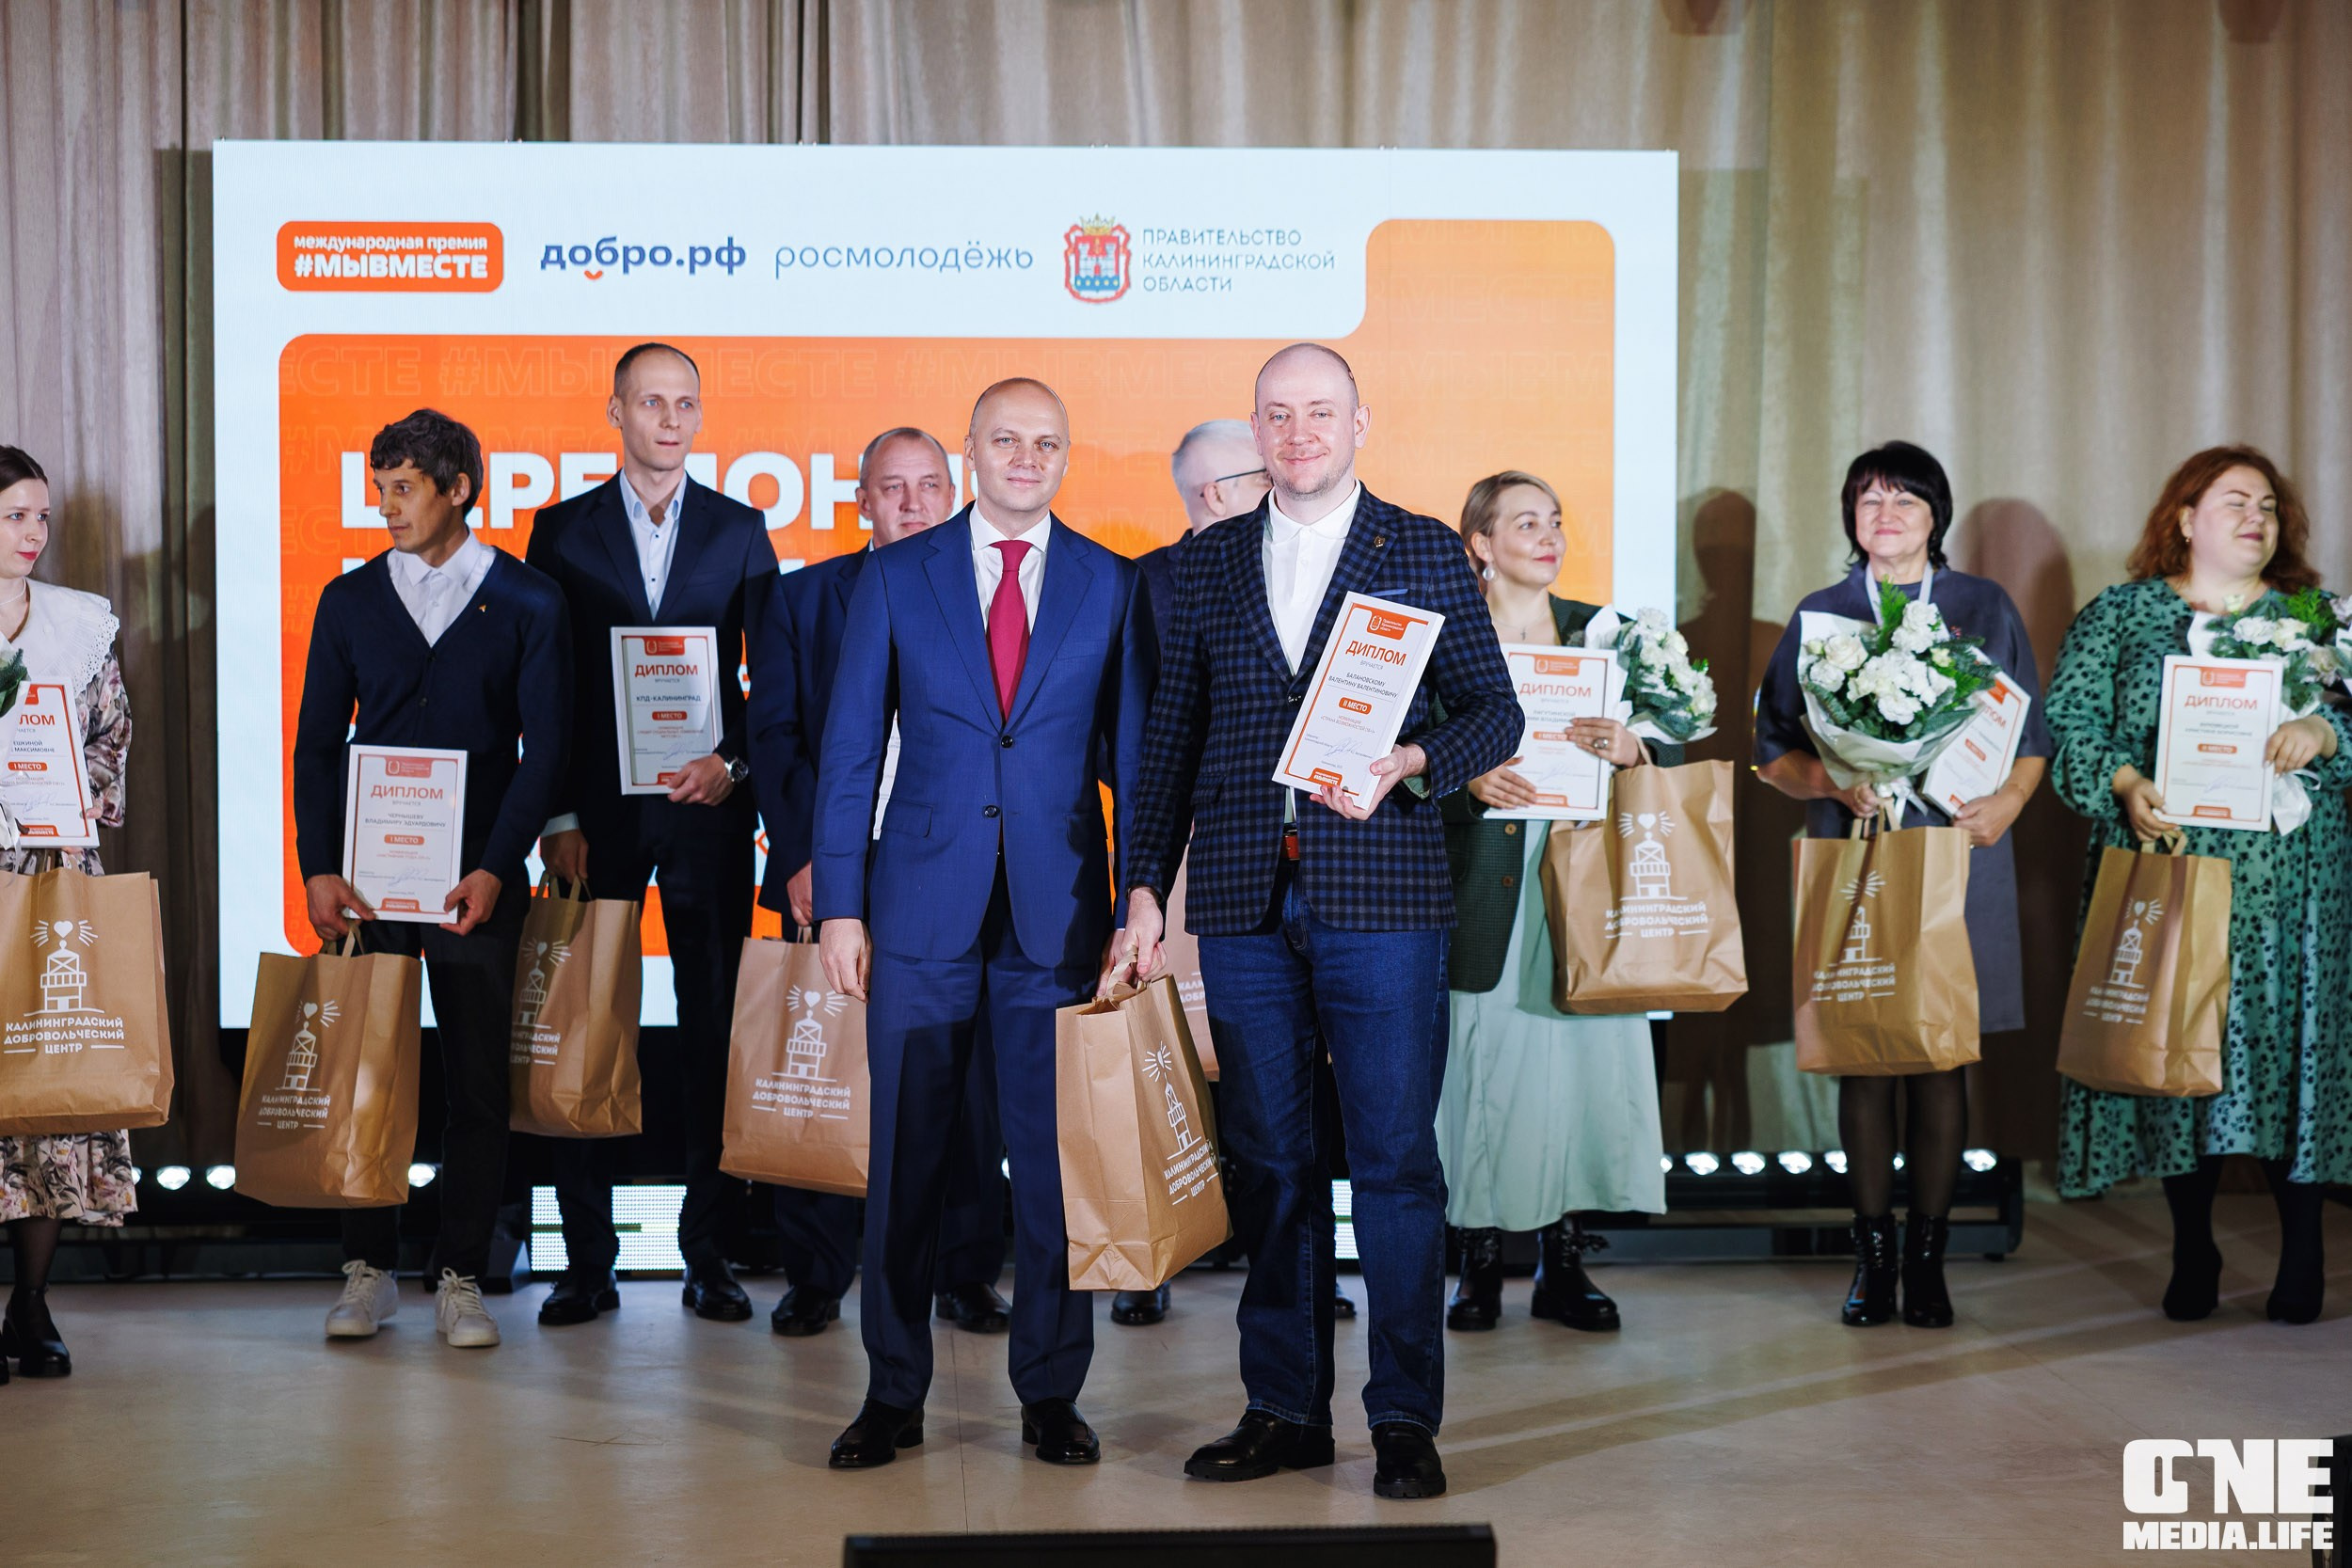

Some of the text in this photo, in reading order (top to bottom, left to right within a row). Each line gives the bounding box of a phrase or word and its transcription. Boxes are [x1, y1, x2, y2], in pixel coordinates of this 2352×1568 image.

[294, 233, 488, 252] международная премия
[1143, 228, 1302, 246] ПРАВИТЕЛЬСТВО
[540, 236, 747, 276] добро.рф
[774, 241, 1034, 279] росмолодёжь
[1143, 248, 1335, 270] КАЛИНИНГРАДСКОЙ
[294, 253, 488, 279] #МЫВМЕСТЕ
[1143, 276, 1232, 293] ОБЛАСТИ
[1344, 641, 1407, 667] ДИПЛОМ
[634, 664, 699, 677] ДИПЛОМ
[1519, 683, 1592, 698] ДИПЛОМ
[1343, 699, 1368, 712] II МЕСТО
[2184, 694, 2258, 710] ДИПЛОМ
[19, 714, 56, 726] ЛОМ
[371, 784, 444, 800] ДИПЛОМ
[1640, 927, 1675, 938] ЦЕНТР
[6, 1016, 123, 1032] КАЛИНИНГРАДСКИЙ
[4, 1029, 125, 1045] ДОБРОВОЛЬЧЕСКИЙ
[44, 1043, 83, 1054] ЦЕНТР
[755, 1078, 851, 1097] КАЛИНИНГРАДСКИЙ
[753, 1091, 850, 1110] ДОБРОВОЛЬЧЕСКИЙ
[783, 1107, 814, 1118] ЦЕНТР
[277, 1120, 299, 1130] ЦЕНТР
[1190, 1180, 1205, 1197] ЦЕНТР
